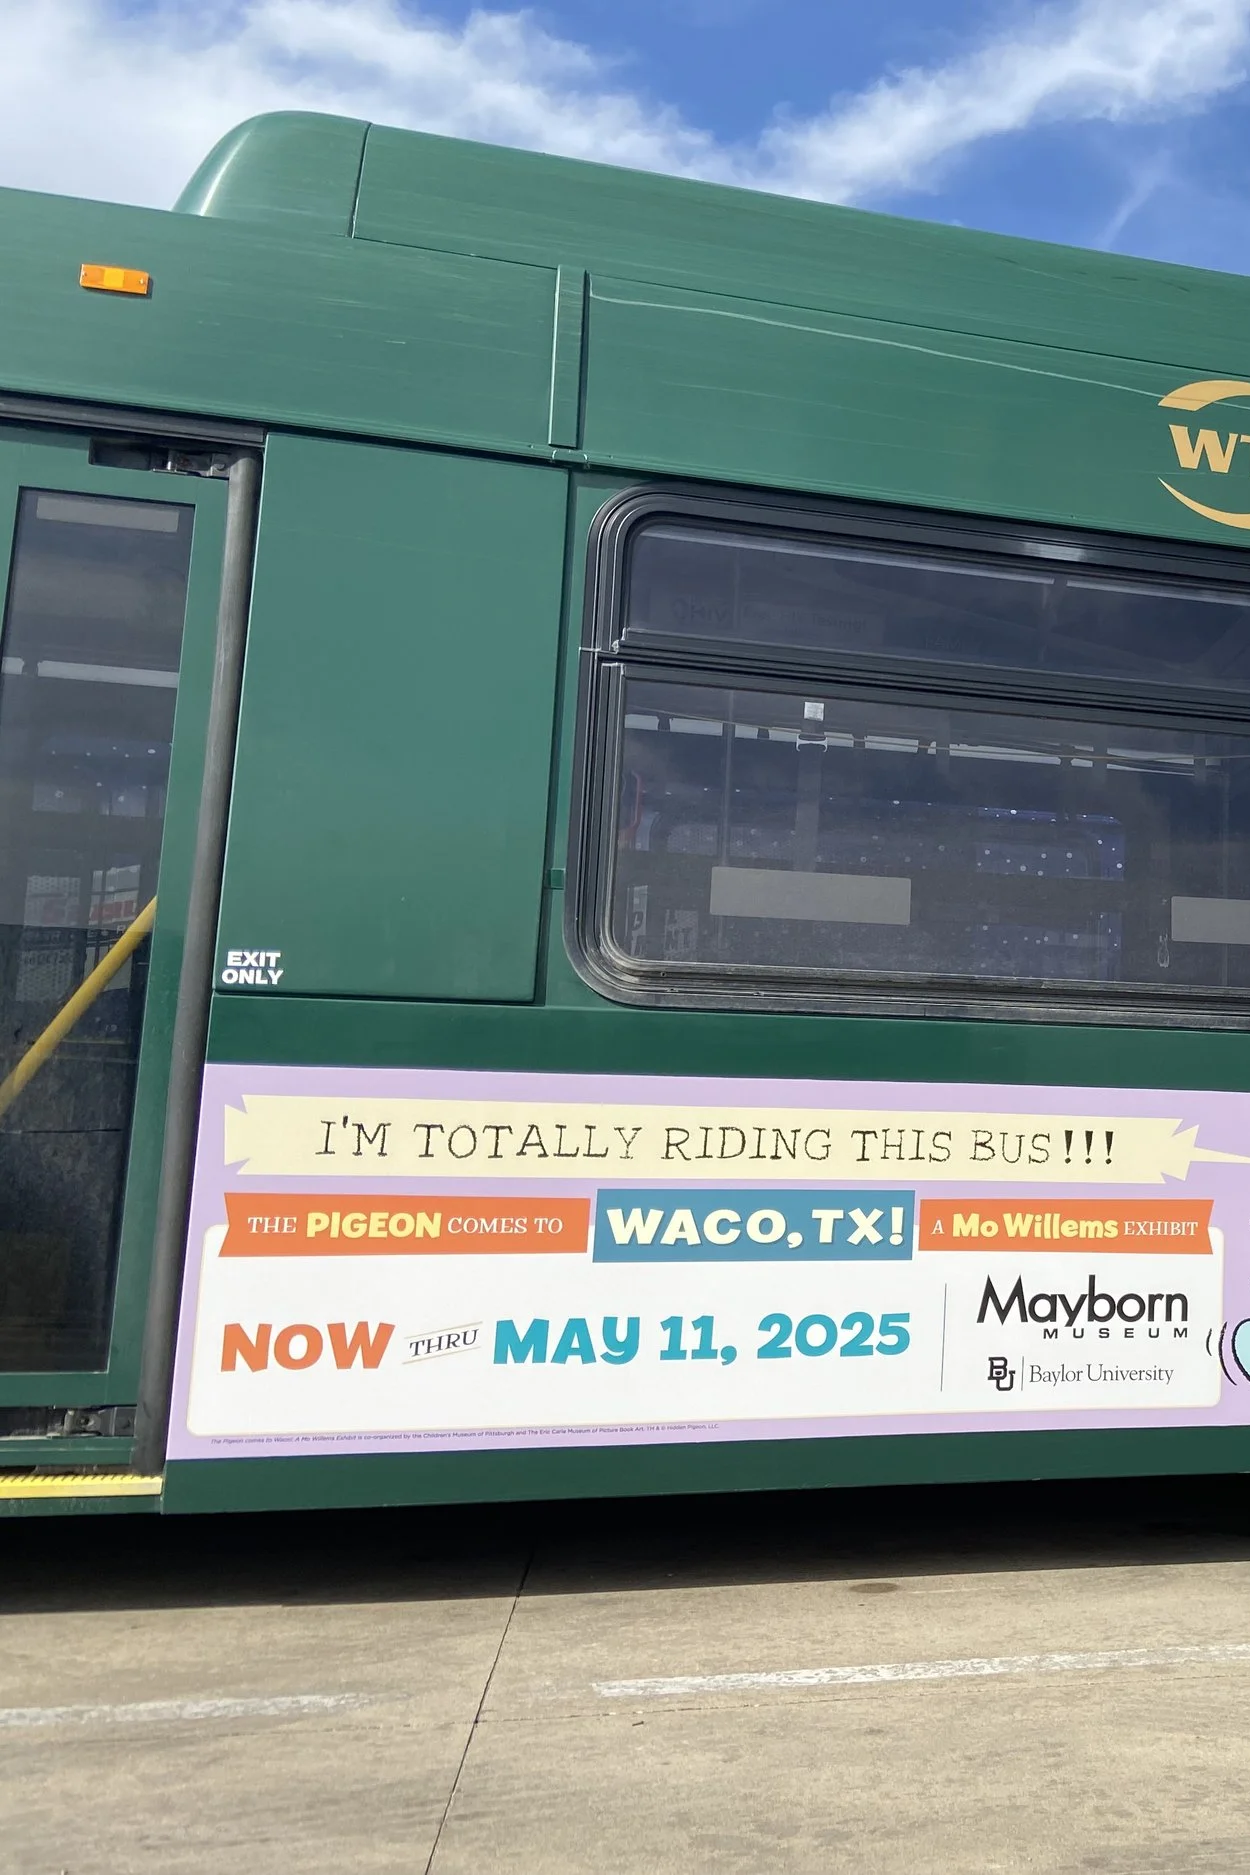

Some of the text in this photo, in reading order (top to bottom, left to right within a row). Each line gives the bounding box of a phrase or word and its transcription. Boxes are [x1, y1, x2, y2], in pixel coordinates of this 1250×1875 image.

[227, 951, 281, 967] EXIT
[222, 968, 283, 985] ONLY
[316, 1116, 1113, 1164] I'M TOTALLY RIDING THIS BUS!!!
[248, 1212, 562, 1238] THE PIGEON COMES TO
[932, 1213, 1198, 1239] A Mo Willems EXHIBIT
[977, 1275, 1188, 1327] Mayborn
[221, 1312, 910, 1372] NOW THRU MAY 11, 2025
[1044, 1328, 1187, 1339] MUSEUM
[1030, 1364, 1083, 1386] Baylor
[1087, 1364, 1173, 1384] University
[363, 1433, 402, 1441] co-organized
